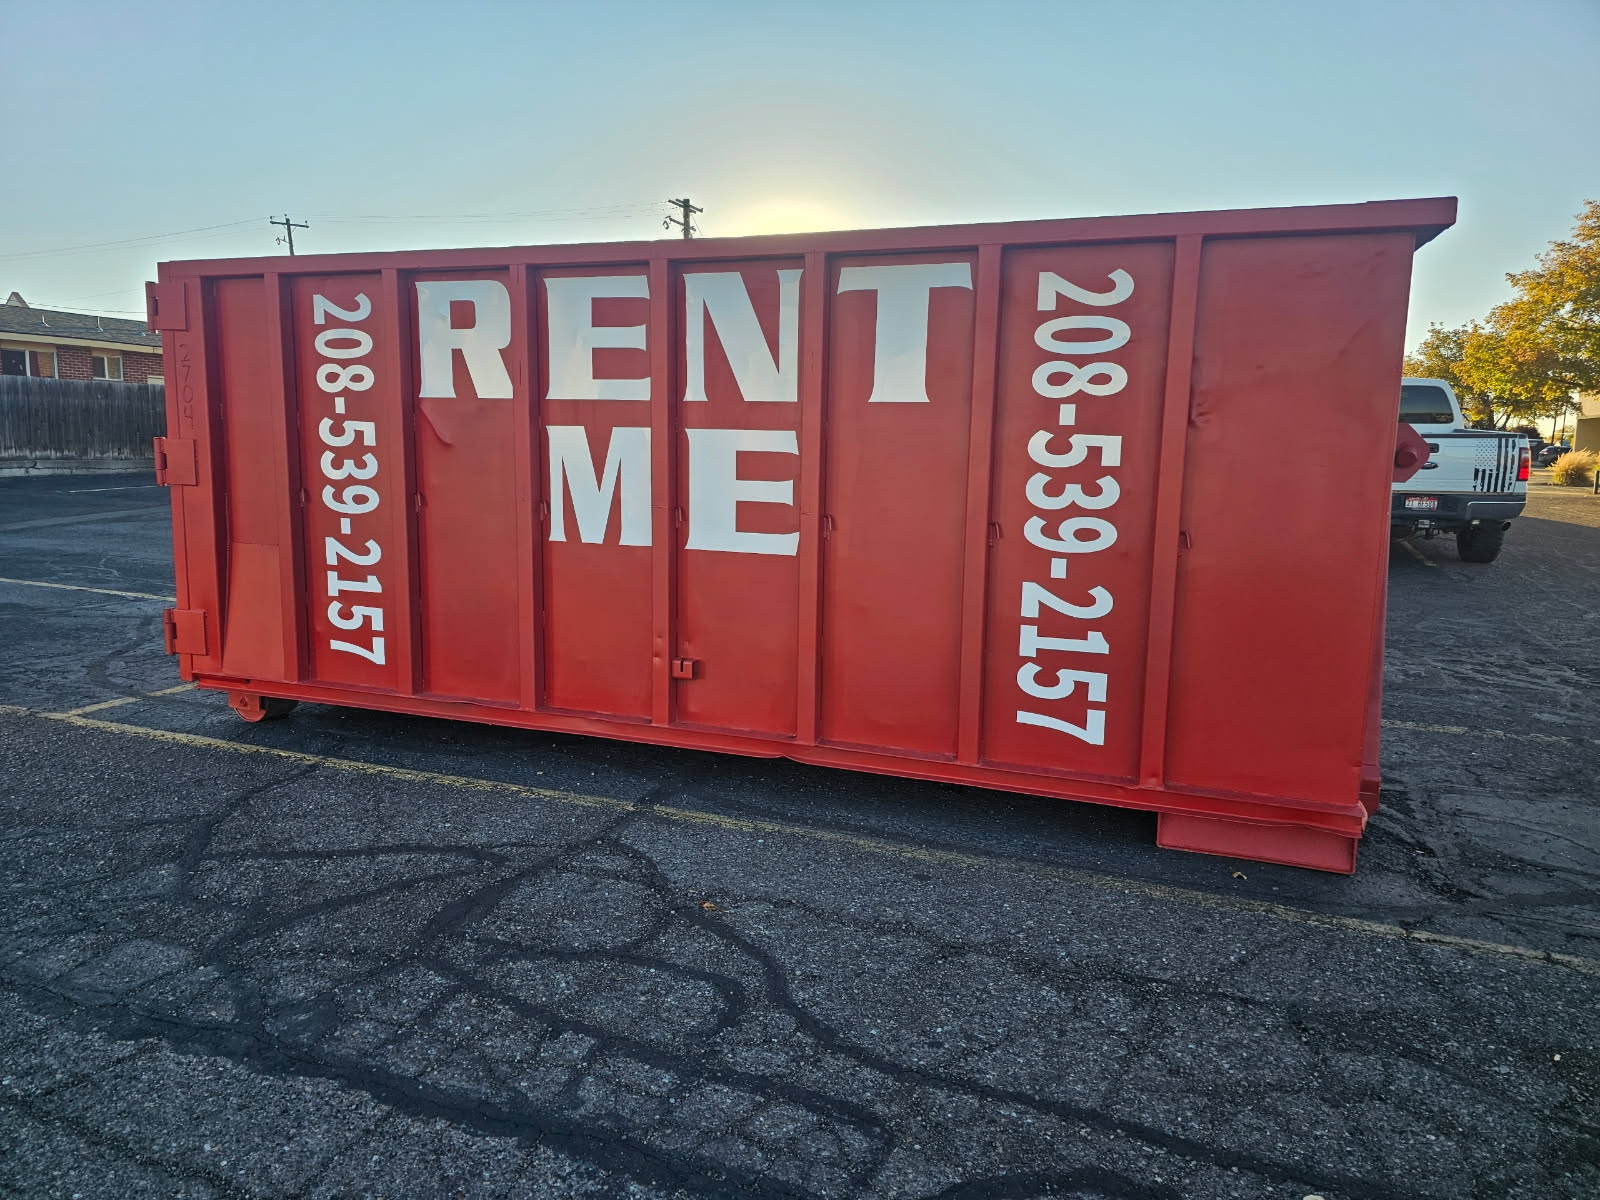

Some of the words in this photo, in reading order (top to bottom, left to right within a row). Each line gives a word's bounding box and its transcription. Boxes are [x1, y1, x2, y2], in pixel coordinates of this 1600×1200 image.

[414, 262, 973, 403] RENT
[312, 292, 386, 665] 208-539-2157
[545, 425, 800, 557] ME
[1016, 268, 1135, 746] 208-539-2157
